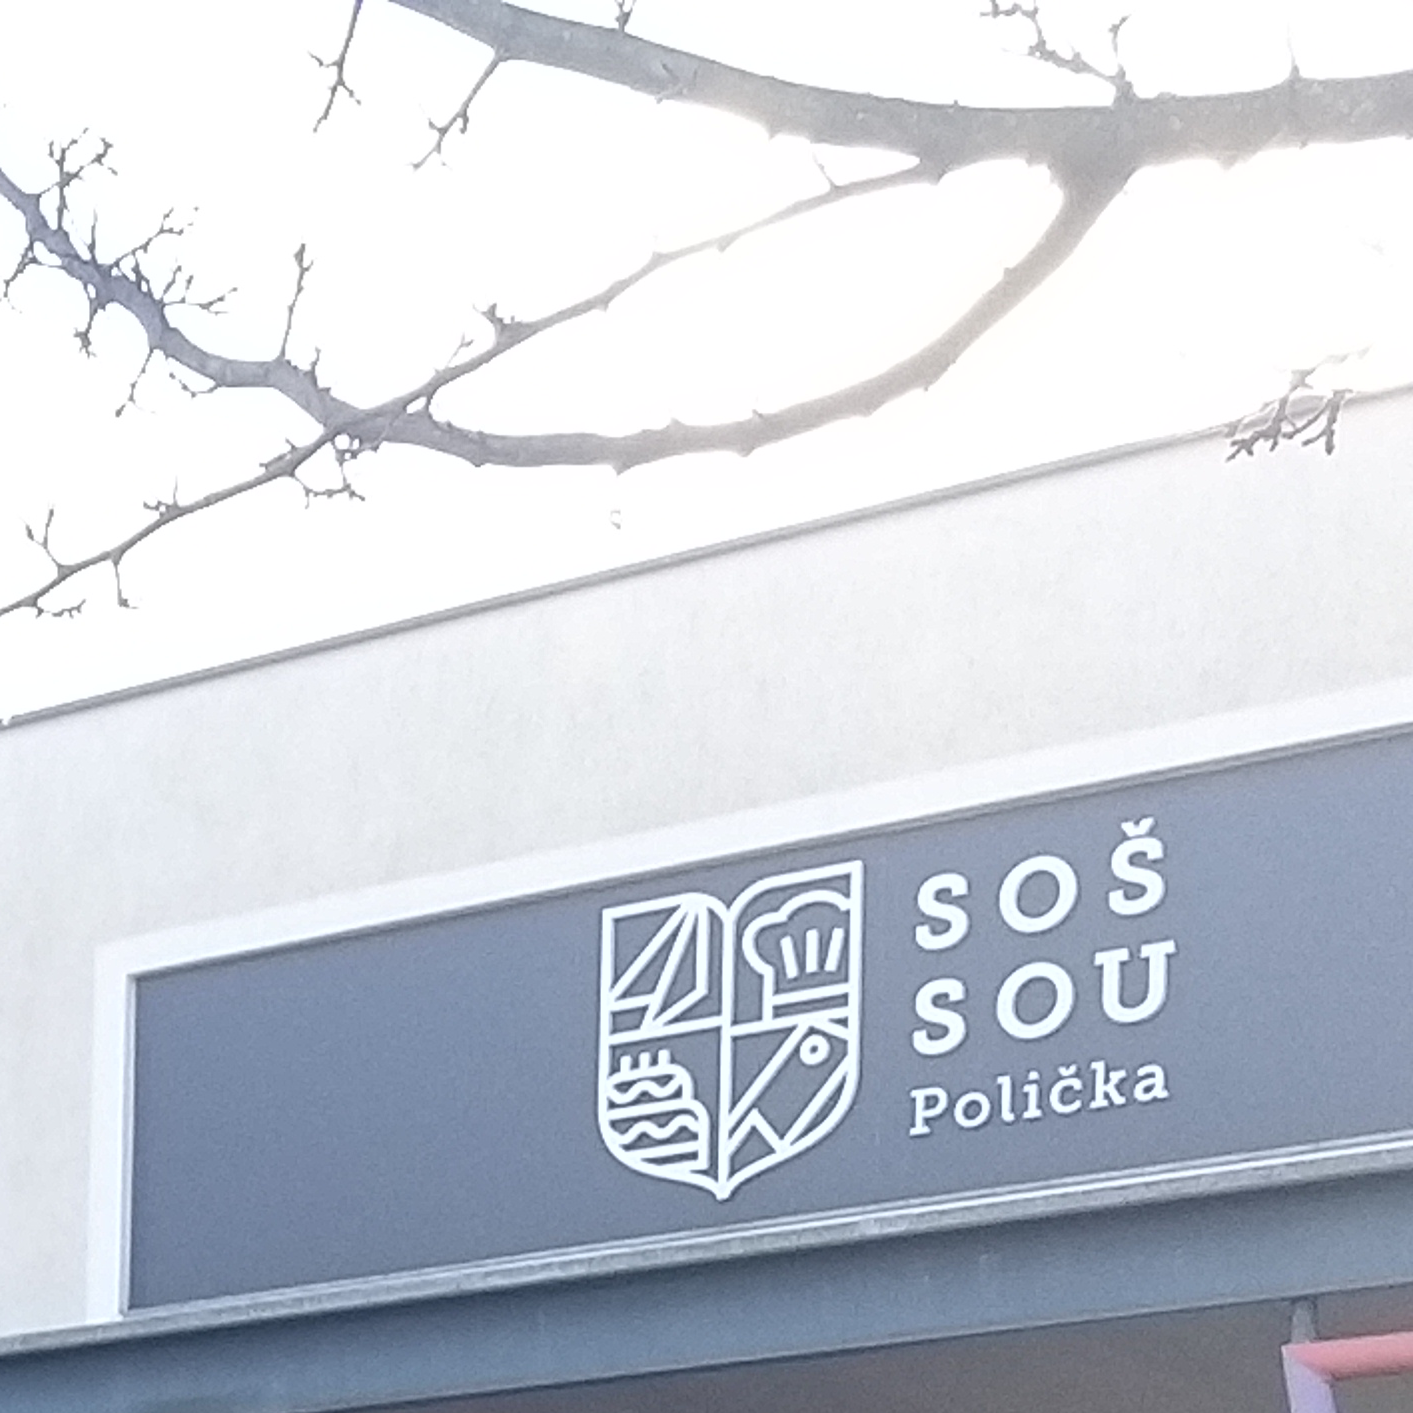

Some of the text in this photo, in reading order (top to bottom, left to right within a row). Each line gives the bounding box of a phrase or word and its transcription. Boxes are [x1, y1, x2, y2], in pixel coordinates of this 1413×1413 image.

[914, 816, 1166, 951] SOŠ
[910, 940, 1177, 1056] SOU
[908, 1060, 1169, 1136] Polička
